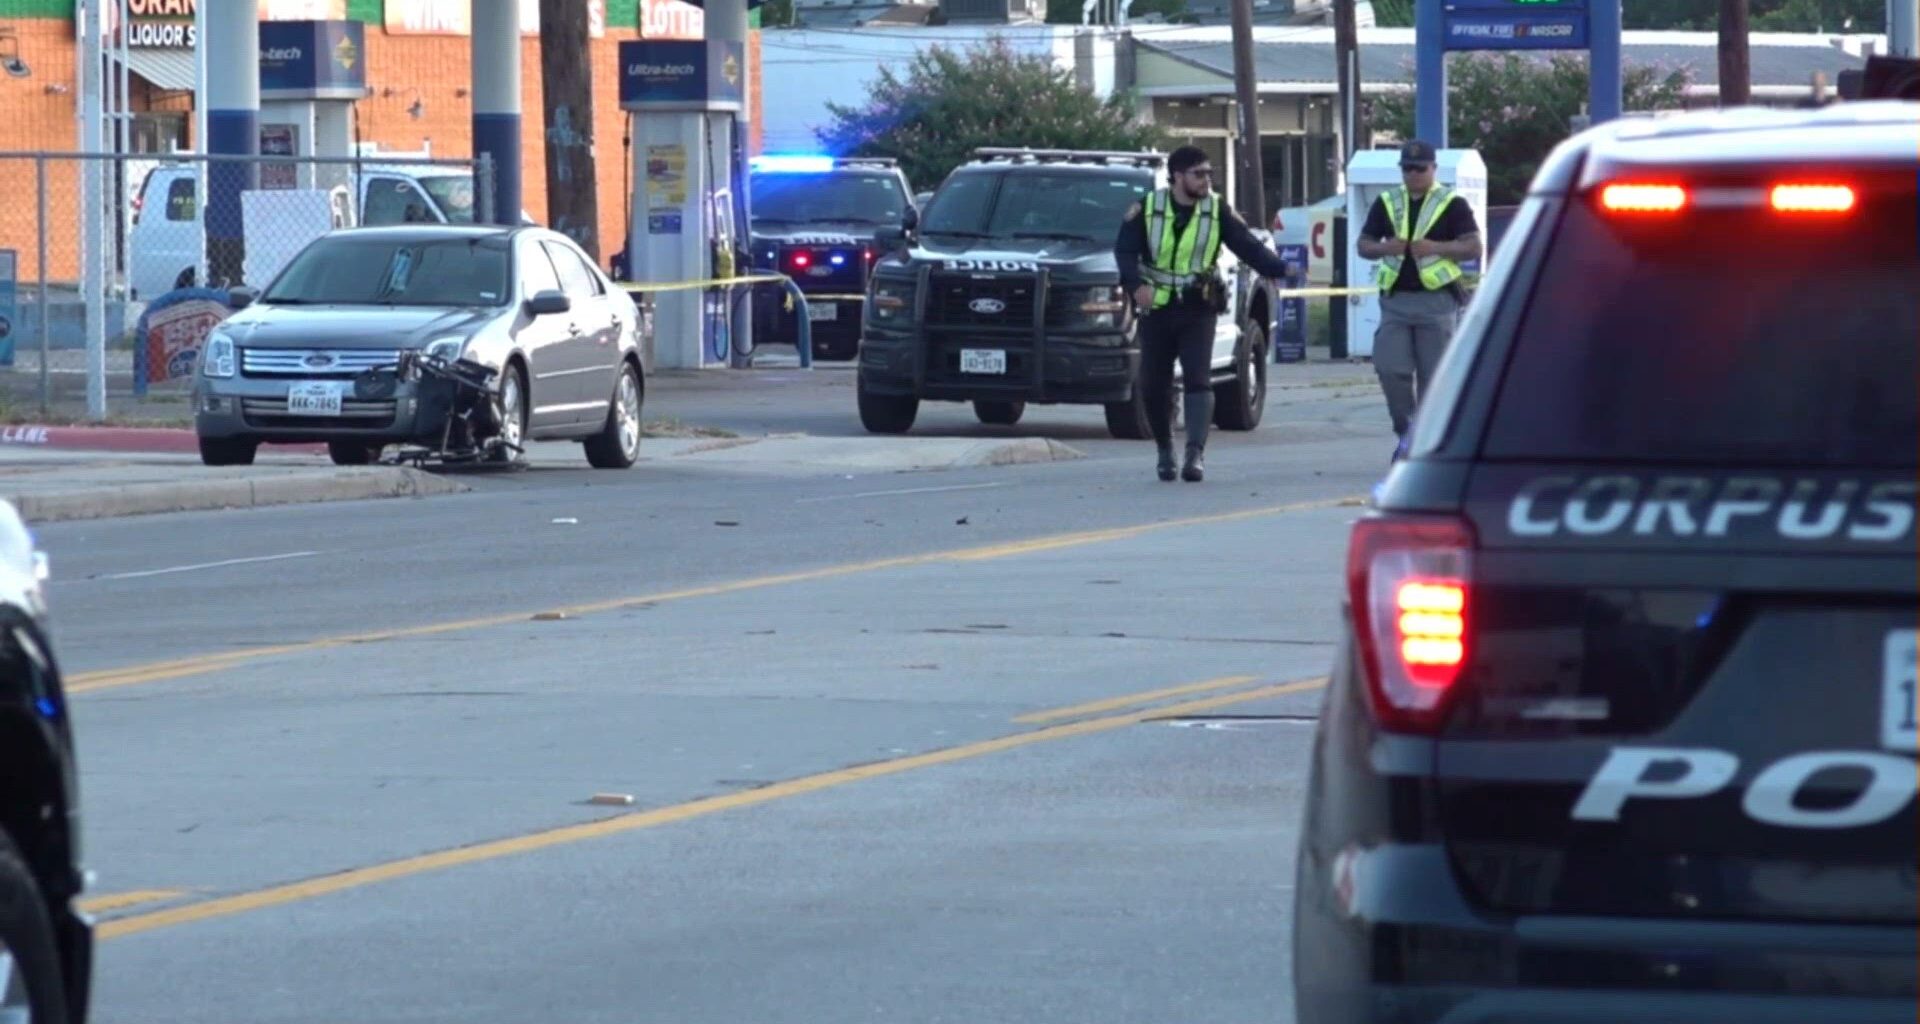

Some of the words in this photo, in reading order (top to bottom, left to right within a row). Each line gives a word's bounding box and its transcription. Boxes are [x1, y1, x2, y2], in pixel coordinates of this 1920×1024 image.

[129, 24, 183, 46] LIQUOR
[1529, 25, 1574, 37] NASCAR
[628, 63, 695, 76] Ultra-tech
[1508, 475, 1914, 540] CORPUS
[1571, 746, 1918, 829] PO
